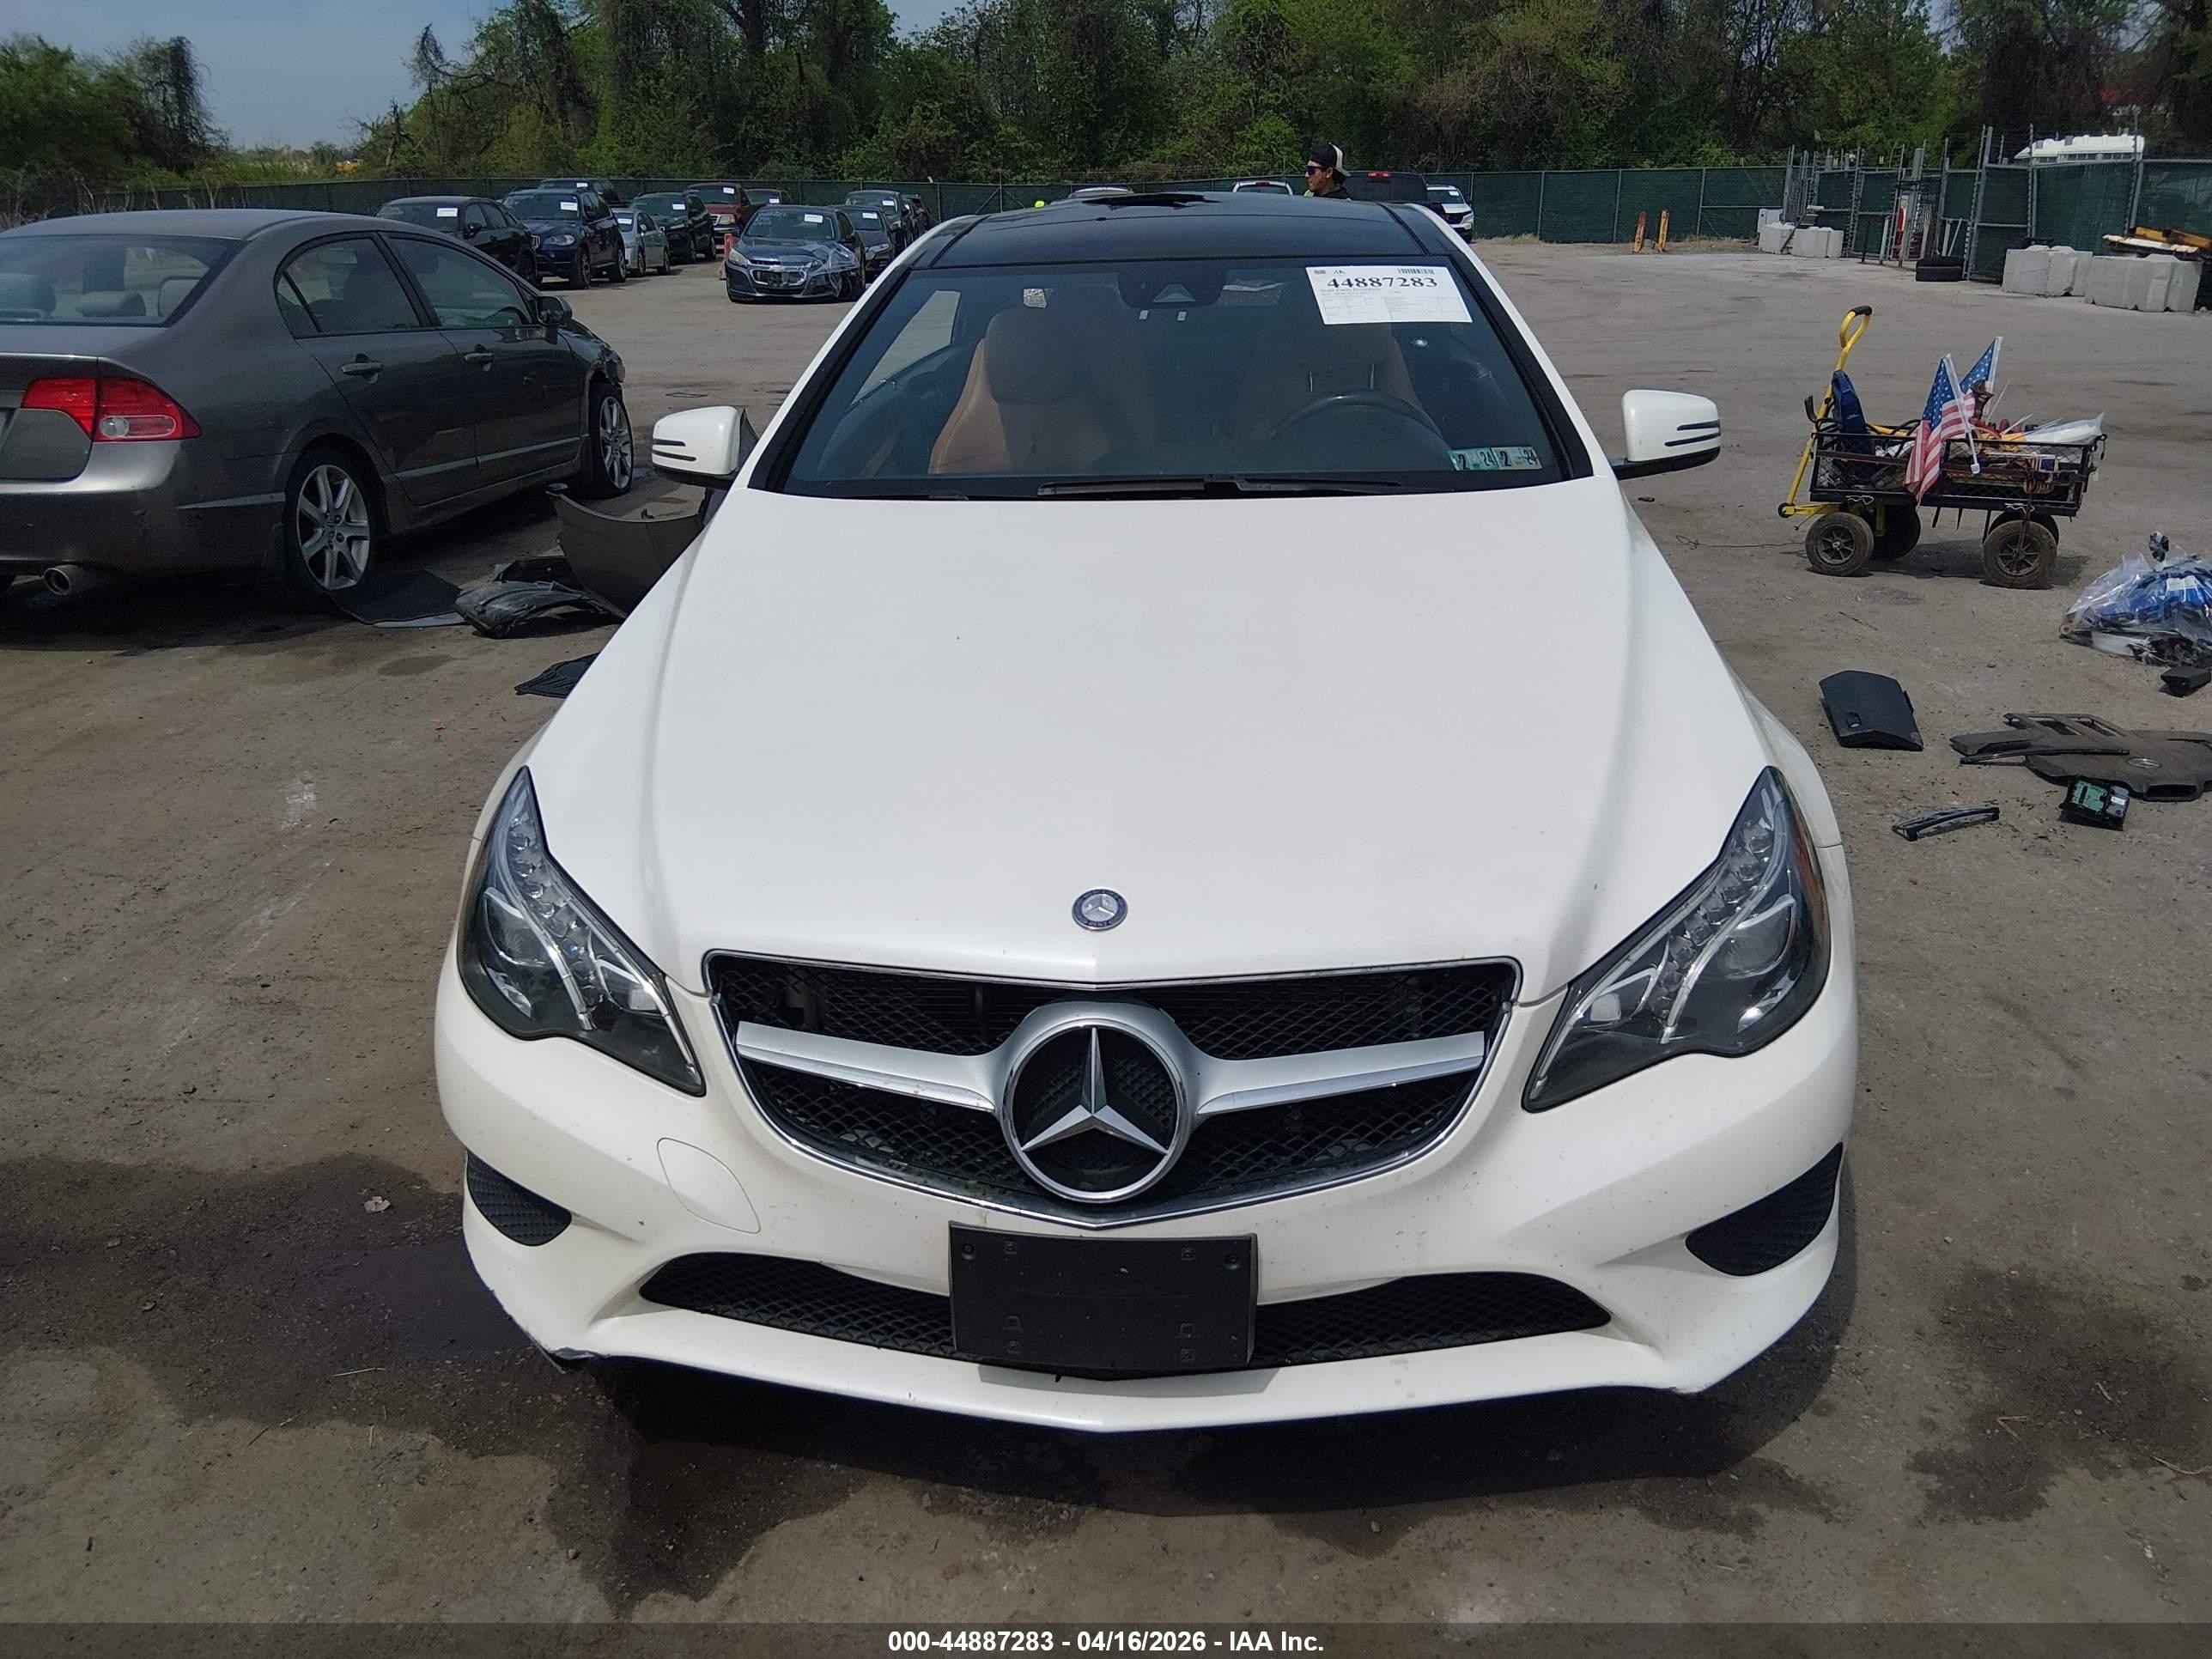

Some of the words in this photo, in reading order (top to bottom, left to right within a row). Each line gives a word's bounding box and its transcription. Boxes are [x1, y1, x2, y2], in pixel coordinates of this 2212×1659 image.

[1327, 277, 1438, 289] 44887283
[1458, 453, 1471, 471] 2
[1479, 451, 1495, 466] 24
